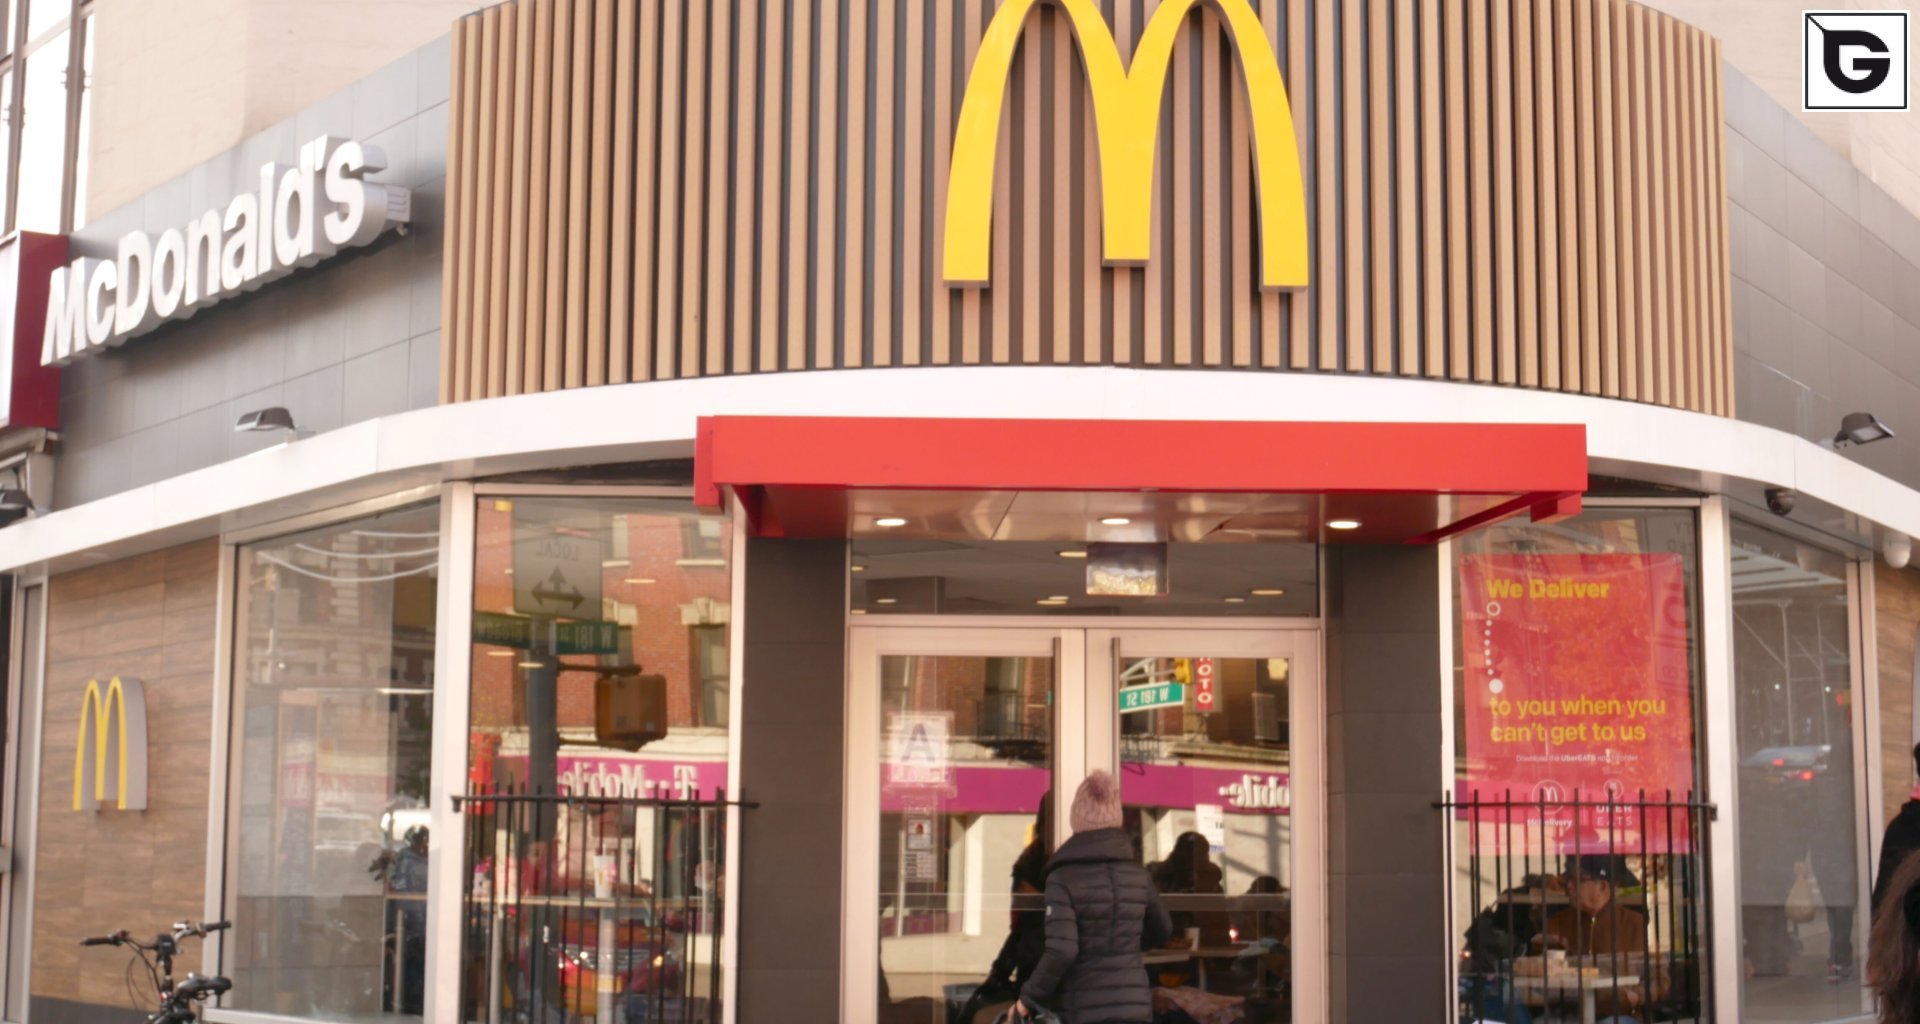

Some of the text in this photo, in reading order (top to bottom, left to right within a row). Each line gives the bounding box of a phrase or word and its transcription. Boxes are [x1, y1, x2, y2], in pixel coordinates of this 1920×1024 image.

[40, 134, 370, 366] McDonald's
[1487, 578, 1611, 599] We Deliver
[1489, 695, 1666, 720] to you when you
[900, 722, 936, 763] A
[1490, 722, 1646, 745] can't get to us
[1527, 818, 1573, 829] Mcelivery
[1596, 816, 1633, 827] ETS
